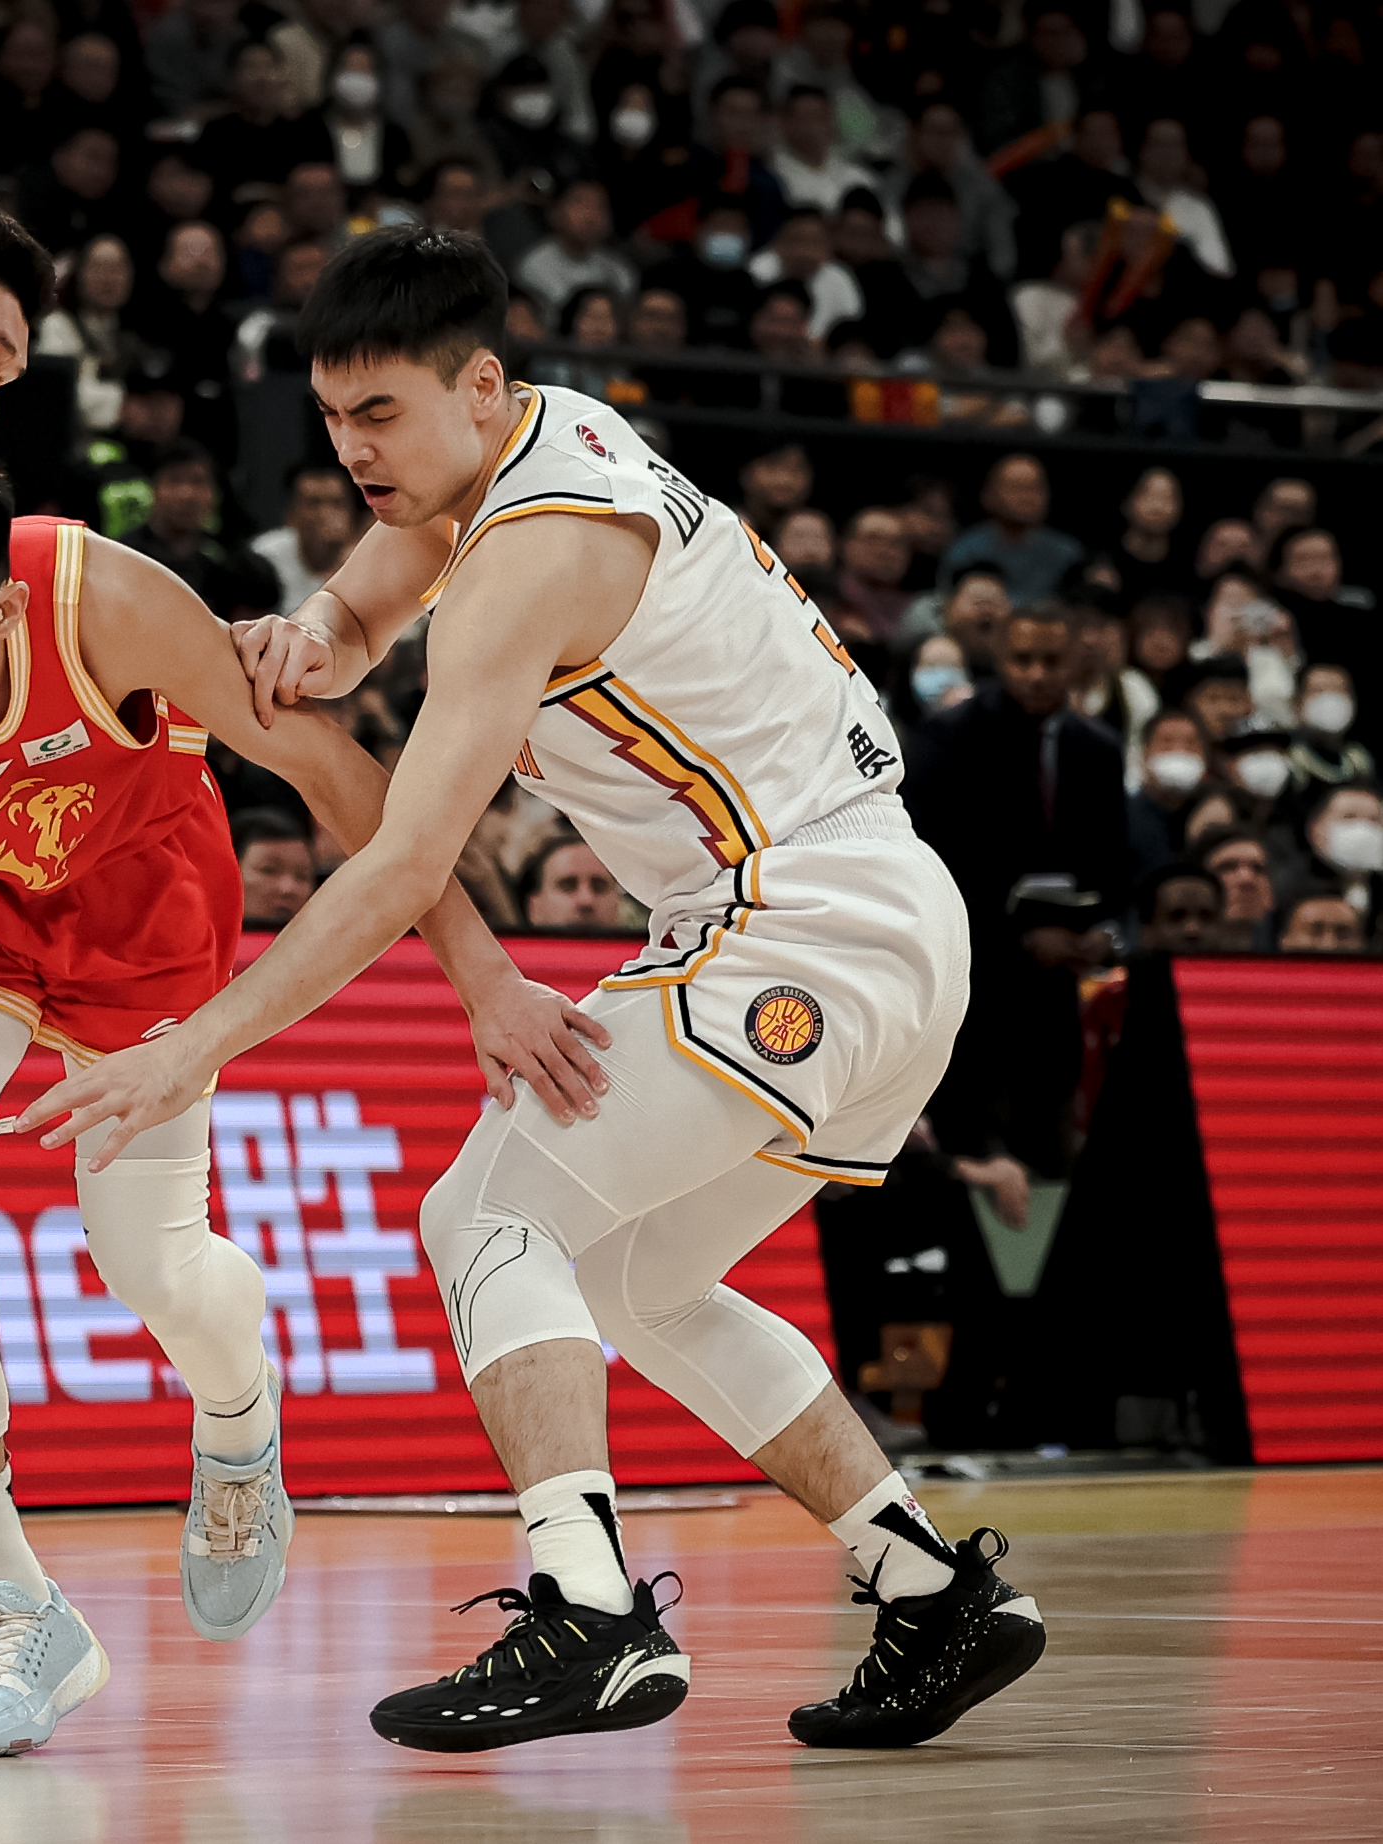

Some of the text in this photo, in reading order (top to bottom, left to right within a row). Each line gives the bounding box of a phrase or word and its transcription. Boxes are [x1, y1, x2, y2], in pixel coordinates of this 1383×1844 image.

[783, 987, 821, 1020] BASKETBALL
[811, 1023, 822, 1044] CLUB
[748, 1030, 794, 1063] SHANXI
